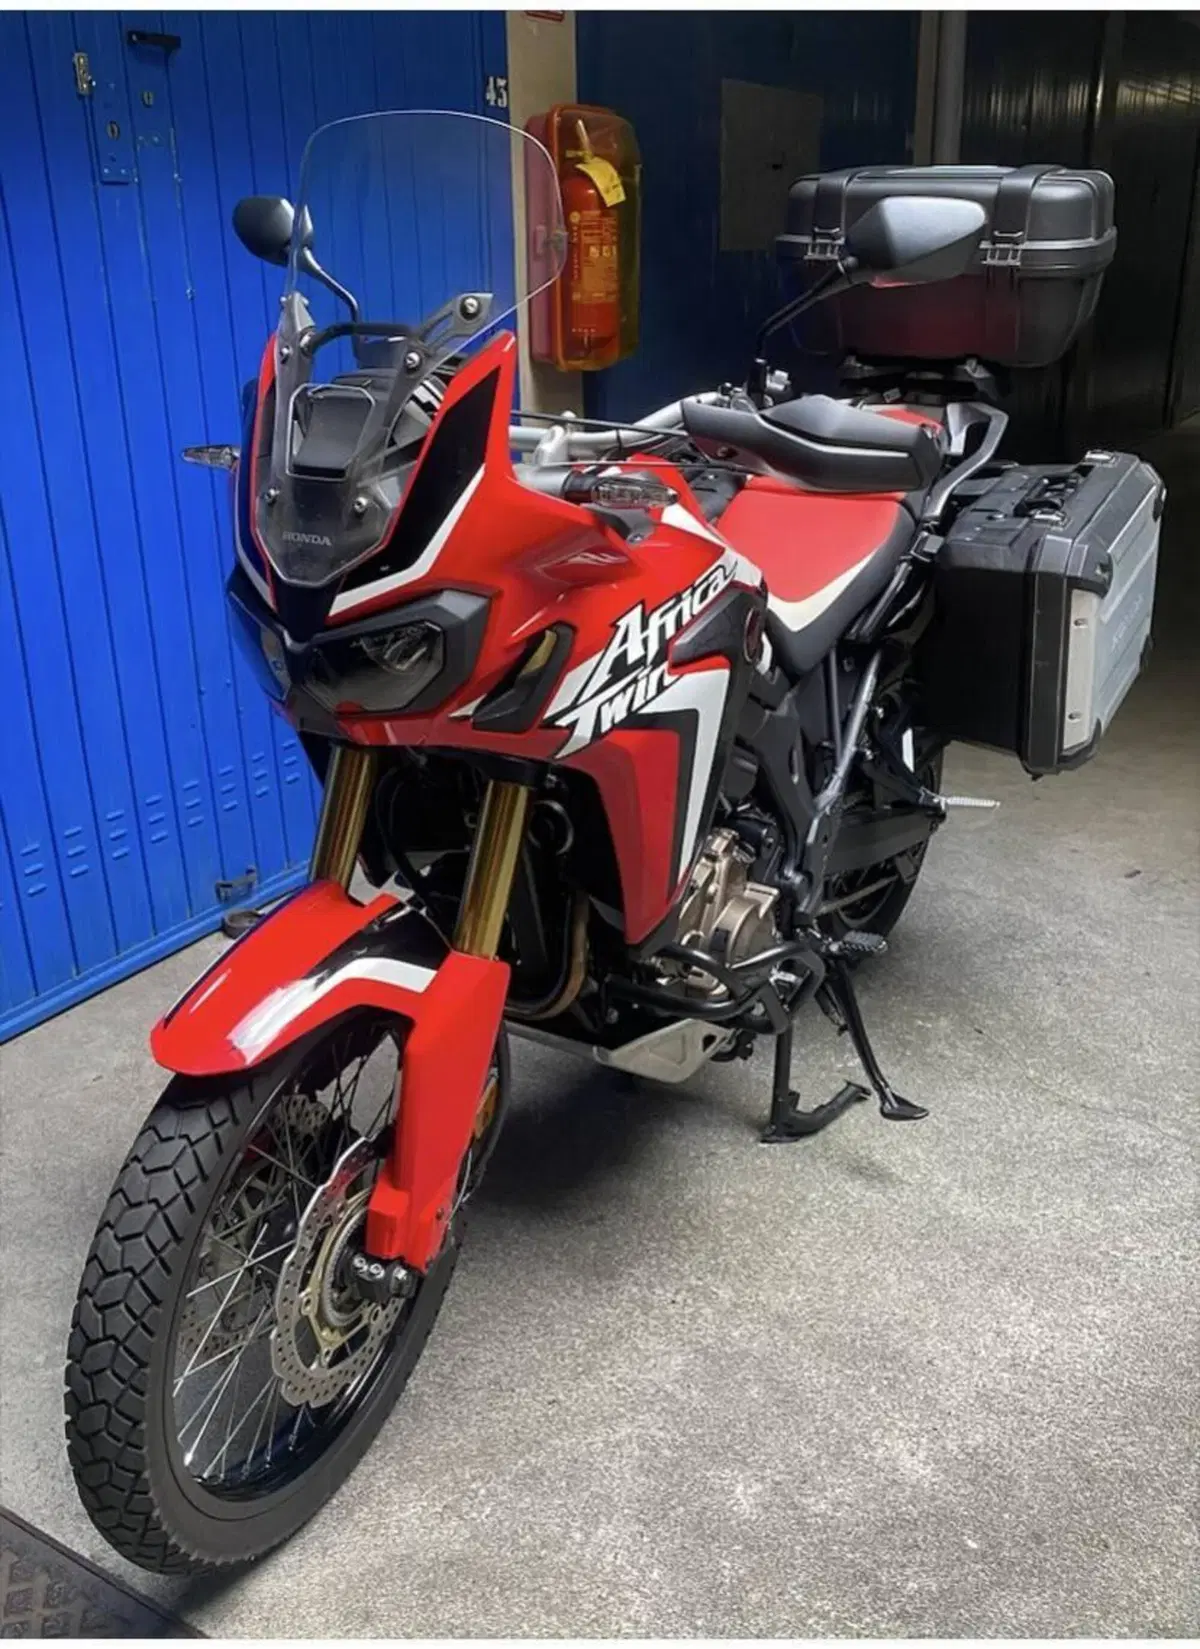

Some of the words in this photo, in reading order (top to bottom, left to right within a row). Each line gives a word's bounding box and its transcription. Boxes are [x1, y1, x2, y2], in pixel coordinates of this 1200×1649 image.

[486, 76, 507, 108] 43
[282, 531, 332, 546] HONDA
[576, 562, 737, 705] Africa
